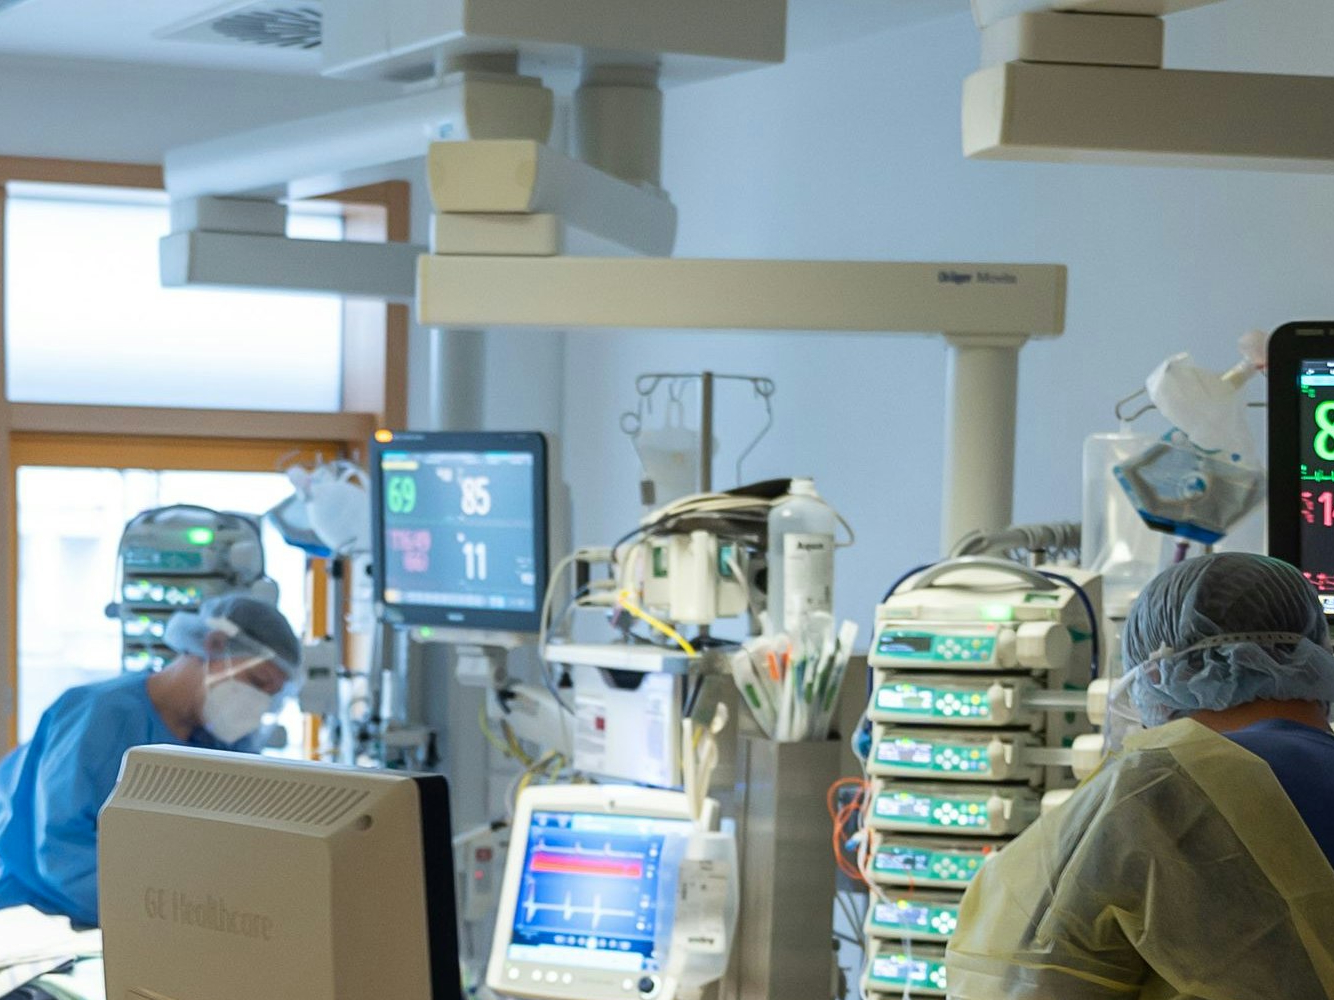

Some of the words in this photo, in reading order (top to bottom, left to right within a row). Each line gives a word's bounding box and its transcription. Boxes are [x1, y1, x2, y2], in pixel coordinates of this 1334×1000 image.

[387, 475, 417, 513] 69
[461, 476, 491, 516] 85
[462, 541, 488, 581] 11
